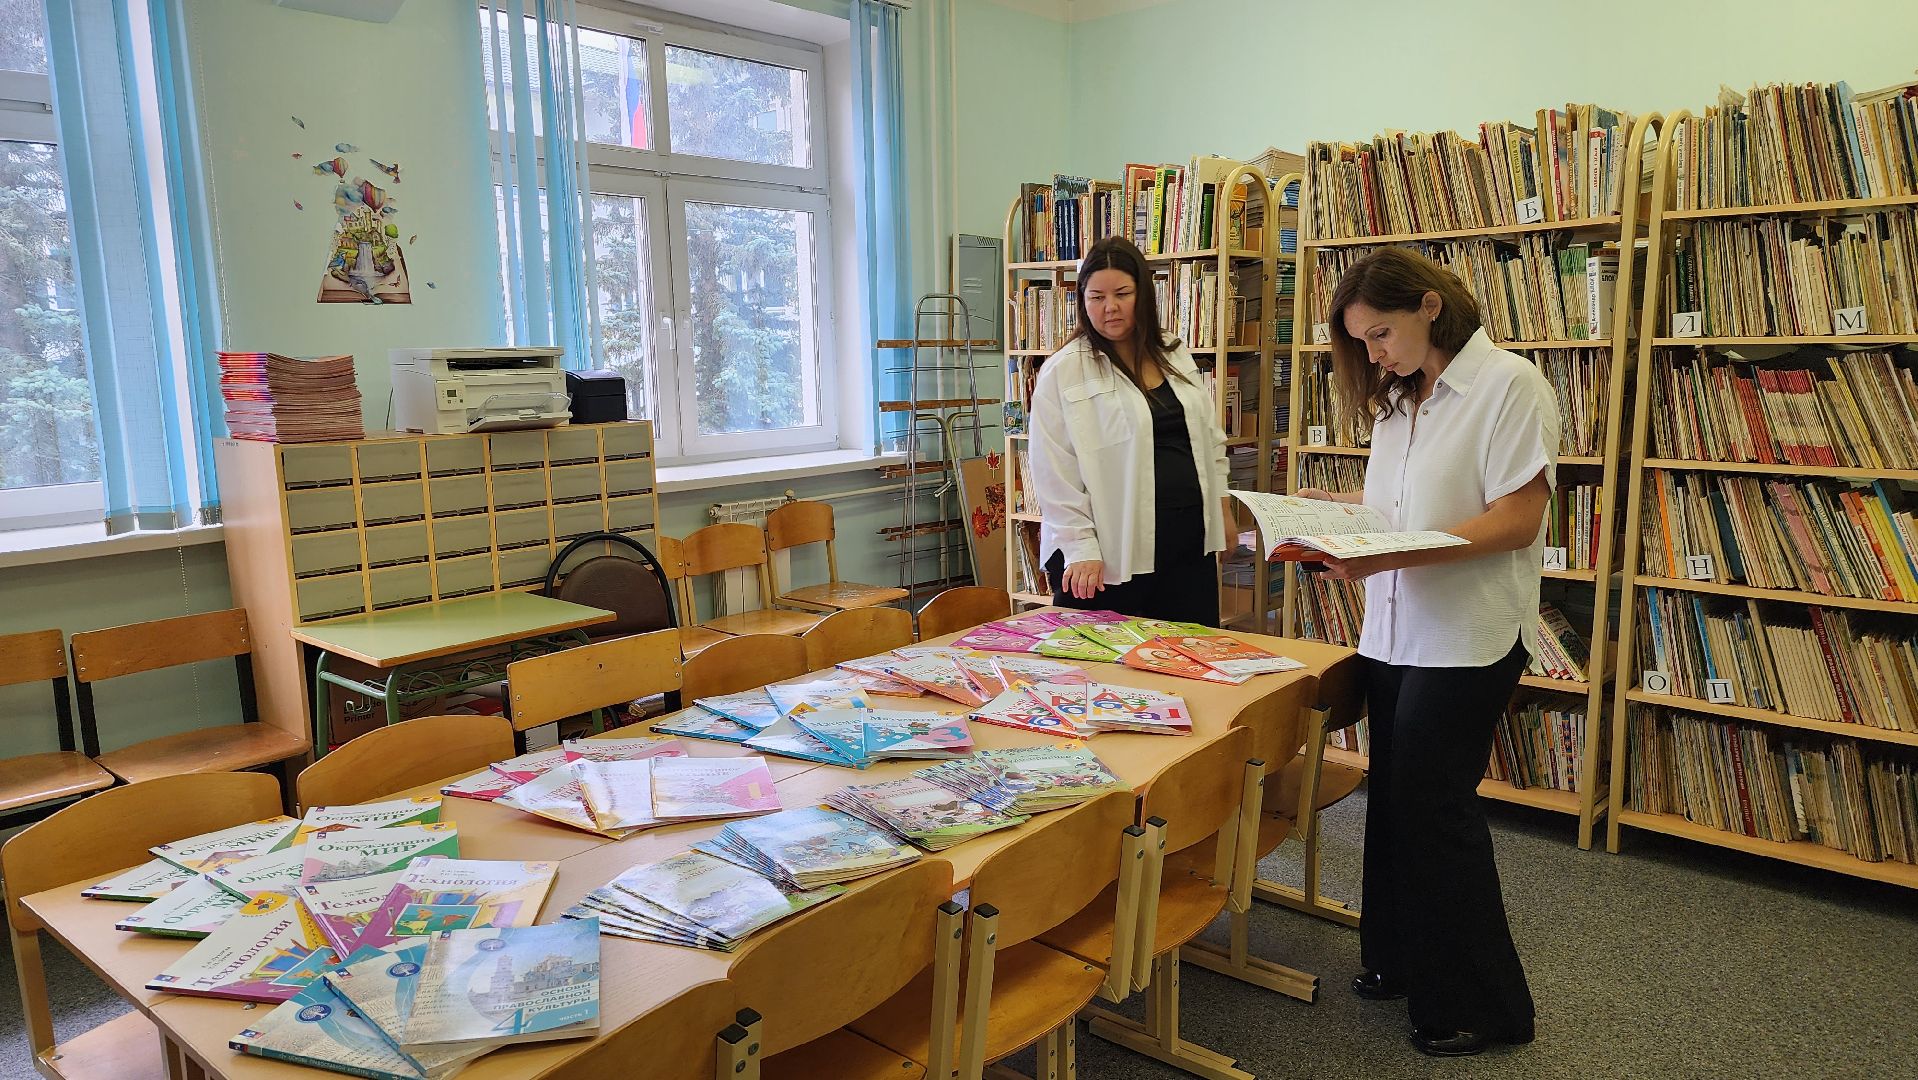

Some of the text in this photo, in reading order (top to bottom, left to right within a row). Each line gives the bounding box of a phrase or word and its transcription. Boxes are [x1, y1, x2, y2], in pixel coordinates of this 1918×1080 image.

[1523, 201, 1537, 219] Б
[1678, 315, 1696, 333] Л
[1837, 310, 1864, 330] М
[1316, 327, 1328, 341] А
[1312, 429, 1322, 443] В
[1546, 549, 1562, 568] Д
[1690, 558, 1712, 575] Н
[1647, 674, 1667, 692] О
[1711, 682, 1731, 699] П
[343, 712, 376, 724] Printer
[1166, 708, 1181, 719] 1
[318, 836, 437, 852] Окружающий
[359, 844, 418, 857] МИР
[407, 872, 520, 888] Технология
[191, 919, 293, 986] Технология
[540, 982, 592, 997] ОСНОВЫ
[492, 989, 592, 1011] ПРАВОСЛАВНОЙ
[527, 996, 592, 1014] КУЛЬТУРЫ
